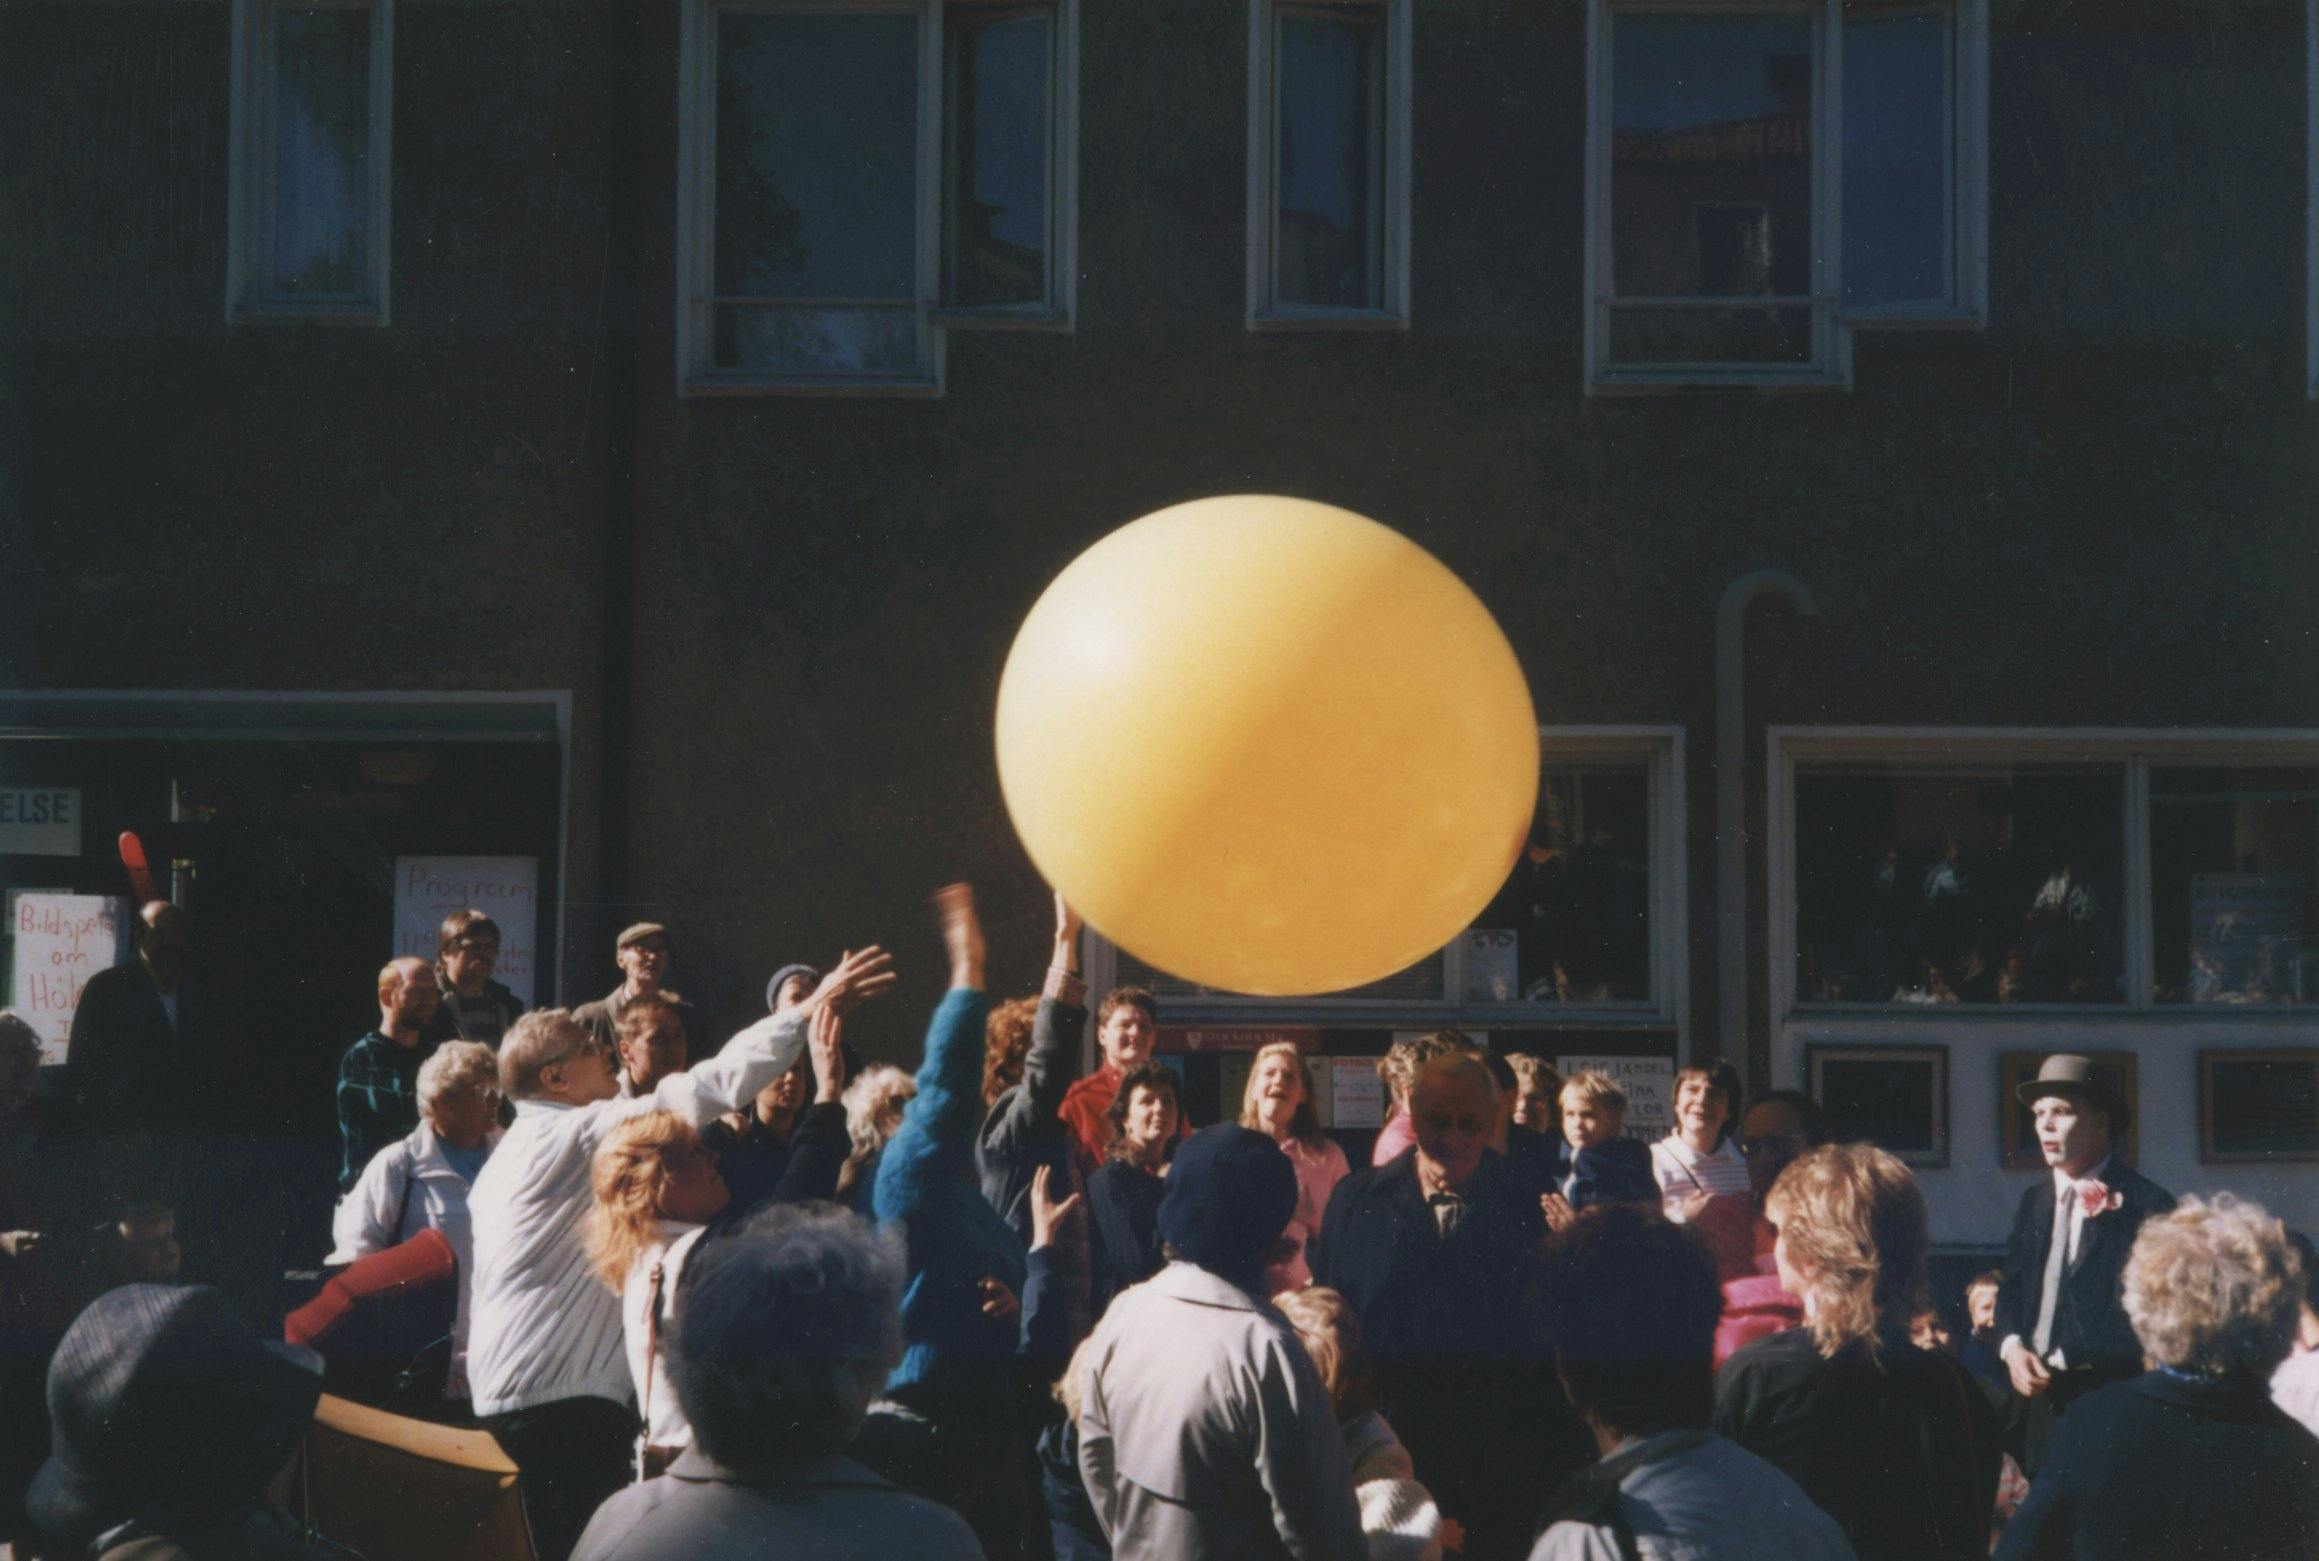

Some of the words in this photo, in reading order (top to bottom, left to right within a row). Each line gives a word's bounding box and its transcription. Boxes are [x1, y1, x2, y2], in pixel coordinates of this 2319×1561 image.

[0, 792, 70, 824] ELSE
[408, 864, 532, 905] Program
[51, 951, 88, 968] om
[1635, 1102, 1663, 1116] LOR
